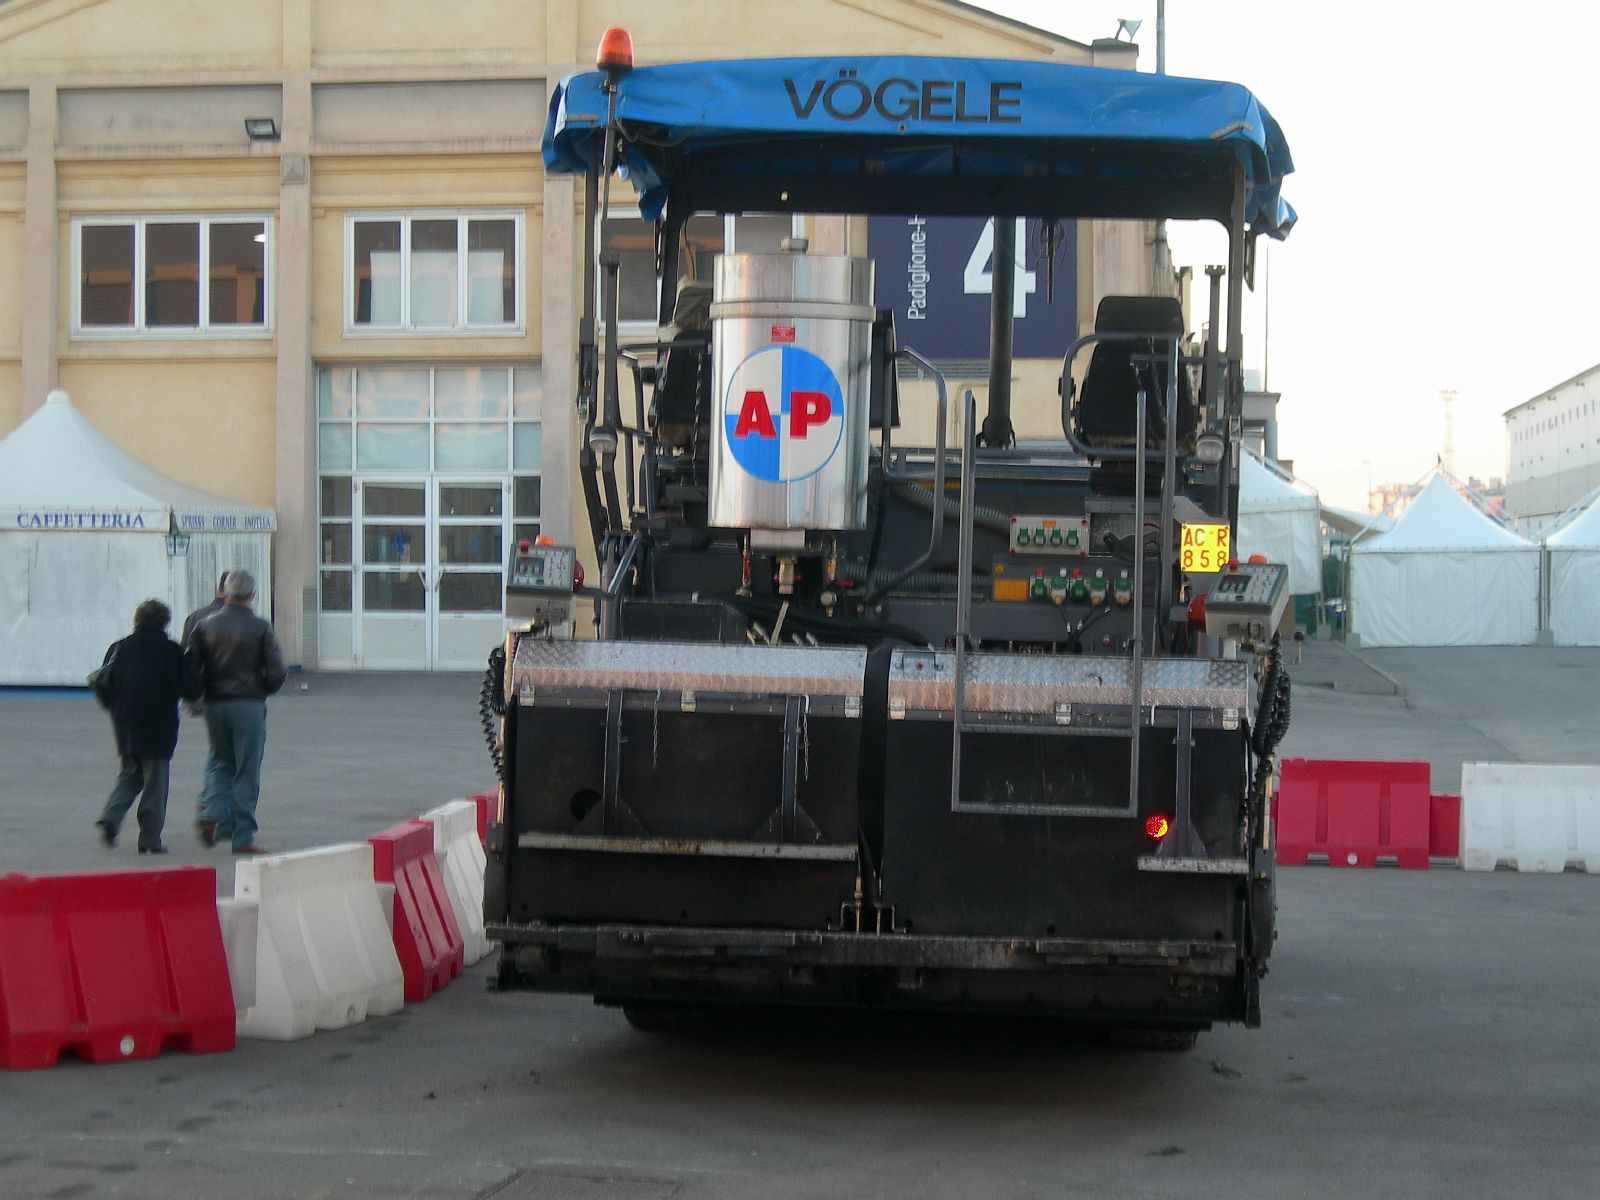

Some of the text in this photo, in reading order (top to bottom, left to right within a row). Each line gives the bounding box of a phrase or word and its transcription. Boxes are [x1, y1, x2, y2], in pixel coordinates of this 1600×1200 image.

[783, 68, 1023, 124] VÖGELE
[963, 215, 1037, 319] 4
[16, 511, 146, 529] CAFFETTERIA
[212, 514, 237, 530] CORNER
[1183, 528, 1205, 547] AC
